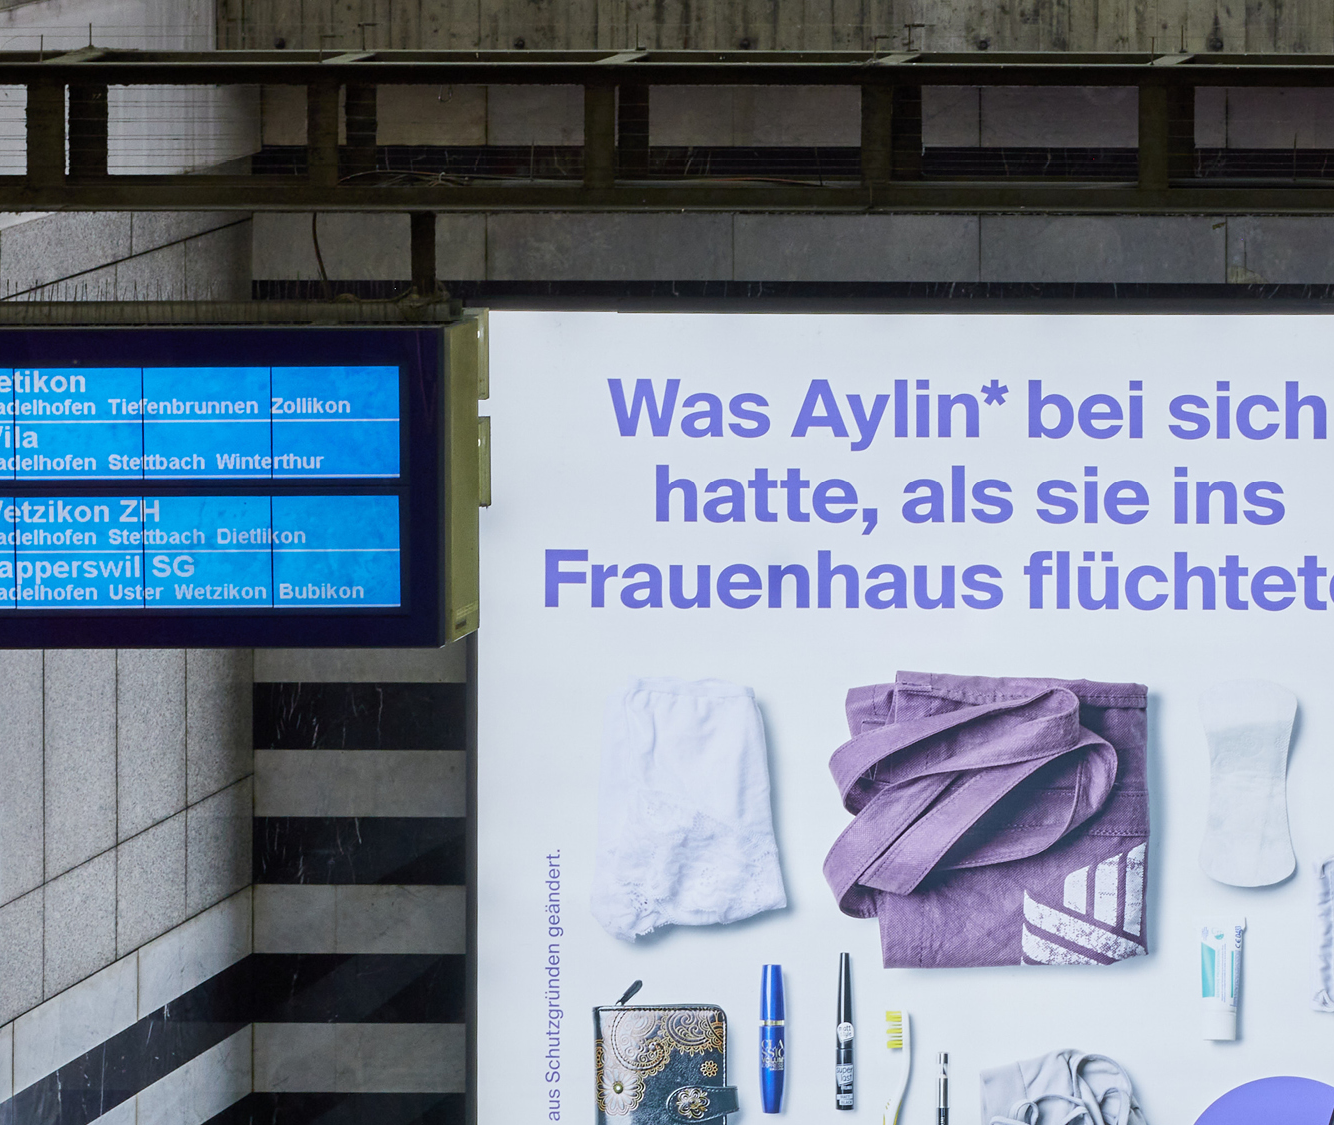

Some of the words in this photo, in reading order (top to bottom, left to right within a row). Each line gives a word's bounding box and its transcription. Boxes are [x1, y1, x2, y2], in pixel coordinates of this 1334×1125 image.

[108, 399, 259, 416] Tiefenbrunnen
[270, 398, 351, 414] Zollikon
[607, 377, 771, 438] Was
[1028, 379, 1144, 440] bei
[1168, 380, 1328, 441] sich
[108, 454, 205, 470] Stettbach
[217, 453, 324, 469] Winterthur
[120, 500, 160, 522] ZH
[655, 464, 878, 536] hatte,
[901, 464, 1014, 524] als
[1036, 465, 1150, 525] sie
[1174, 466, 1286, 526] ins
[108, 529, 205, 545] Stettbach
[217, 528, 306, 544] Dietlikon
[153, 556, 195, 577] SG
[544, 548, 1004, 610] Frauenhaus
[109, 584, 164, 600] Uster
[174, 584, 267, 600] Wetzikon
[279, 583, 365, 599] Bubikon
[544, 849, 564, 937] geändert.
[545, 944, 564, 1083] Schutzgründen
[548, 1089, 561, 1122] aus
